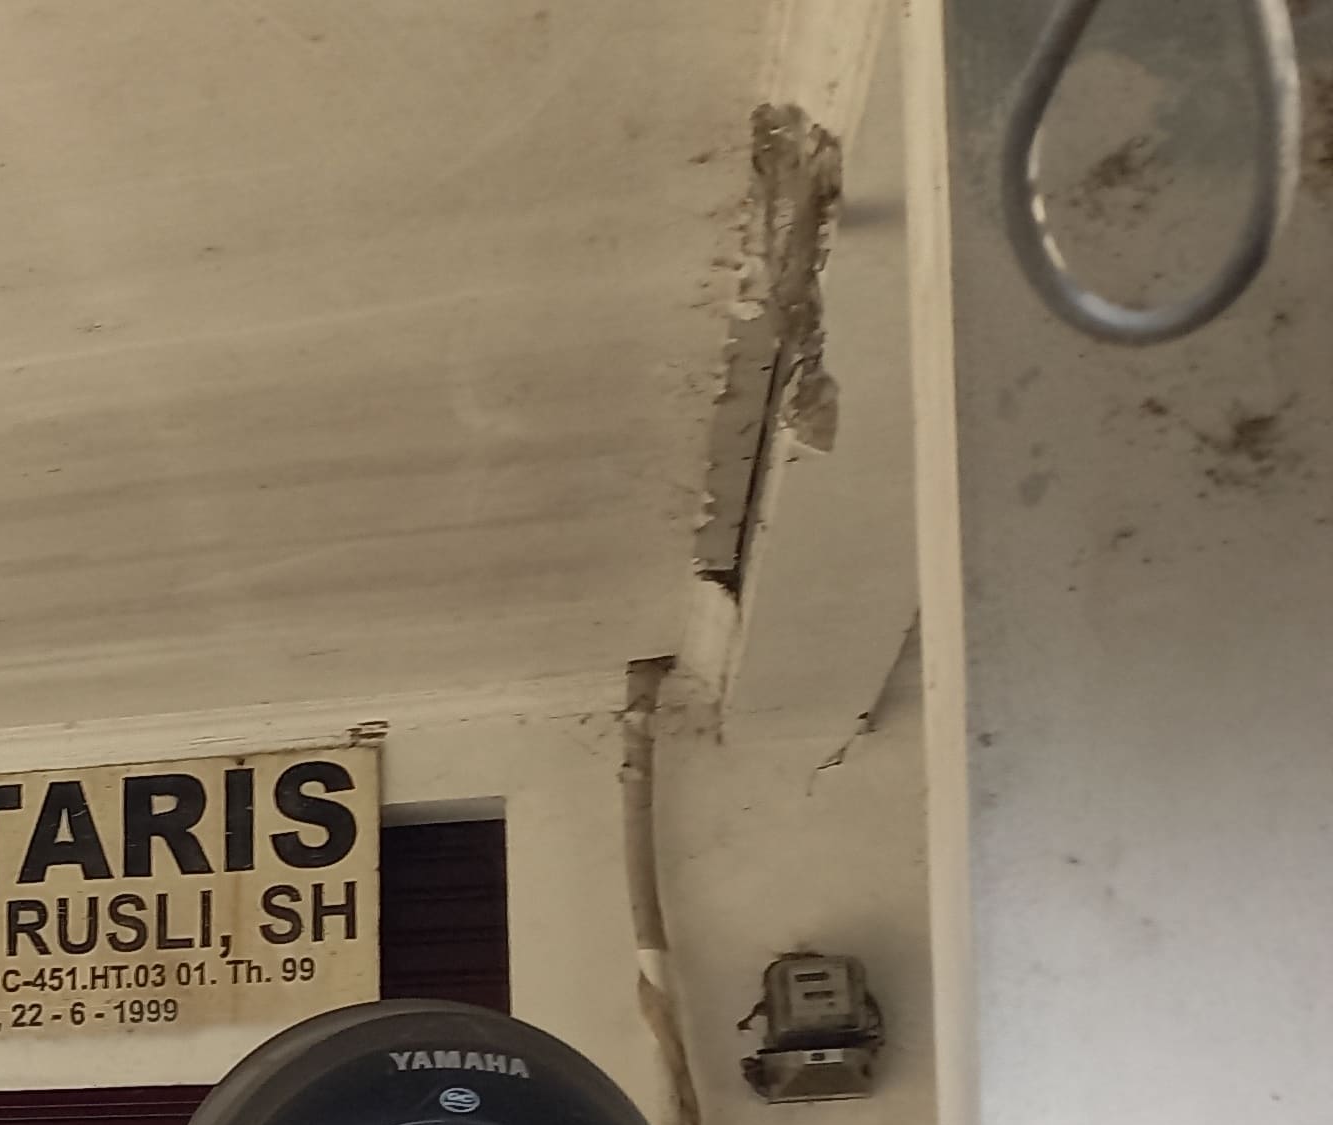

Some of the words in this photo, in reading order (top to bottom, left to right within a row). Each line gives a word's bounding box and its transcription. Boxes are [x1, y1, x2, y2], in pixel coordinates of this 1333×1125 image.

[6, 890, 231, 958] RUSLI,
[258, 881, 358, 946] SH
[226, 959, 271, 984] Th.
[282, 957, 316, 982] 99
[11, 1003, 43, 1027] 22
[69, 1002, 85, 1025] 6
[113, 1000, 178, 1023] 1999
[389, 1051, 530, 1078] YAMAHA
